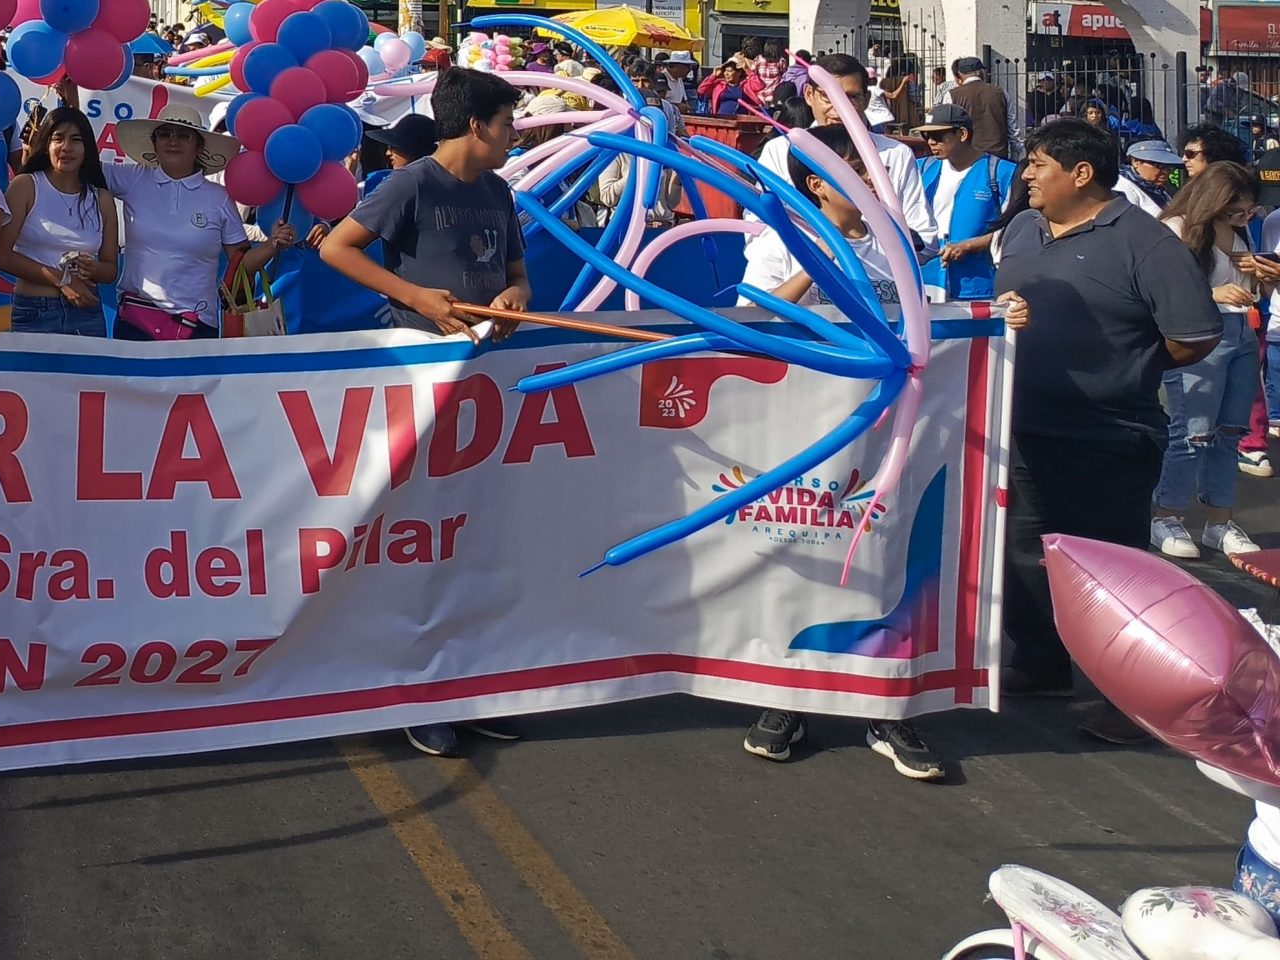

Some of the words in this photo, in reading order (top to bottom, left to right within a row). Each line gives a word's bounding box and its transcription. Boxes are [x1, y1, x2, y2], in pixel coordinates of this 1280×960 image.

[1081, 13, 1125, 31] apue
[657, 399, 673, 409] 20
[661, 408, 676, 418] 23
[76, 390, 242, 503] LA
[276, 362, 597, 497] VIDA
[767, 486, 835, 509] VIDA
[738, 504, 855, 529] FAMILIA
[752, 525, 843, 540] AREQUIPA
[144, 527, 267, 598] del
[297, 511, 469, 595] Pilar
[70, 637, 280, 688] 2027
